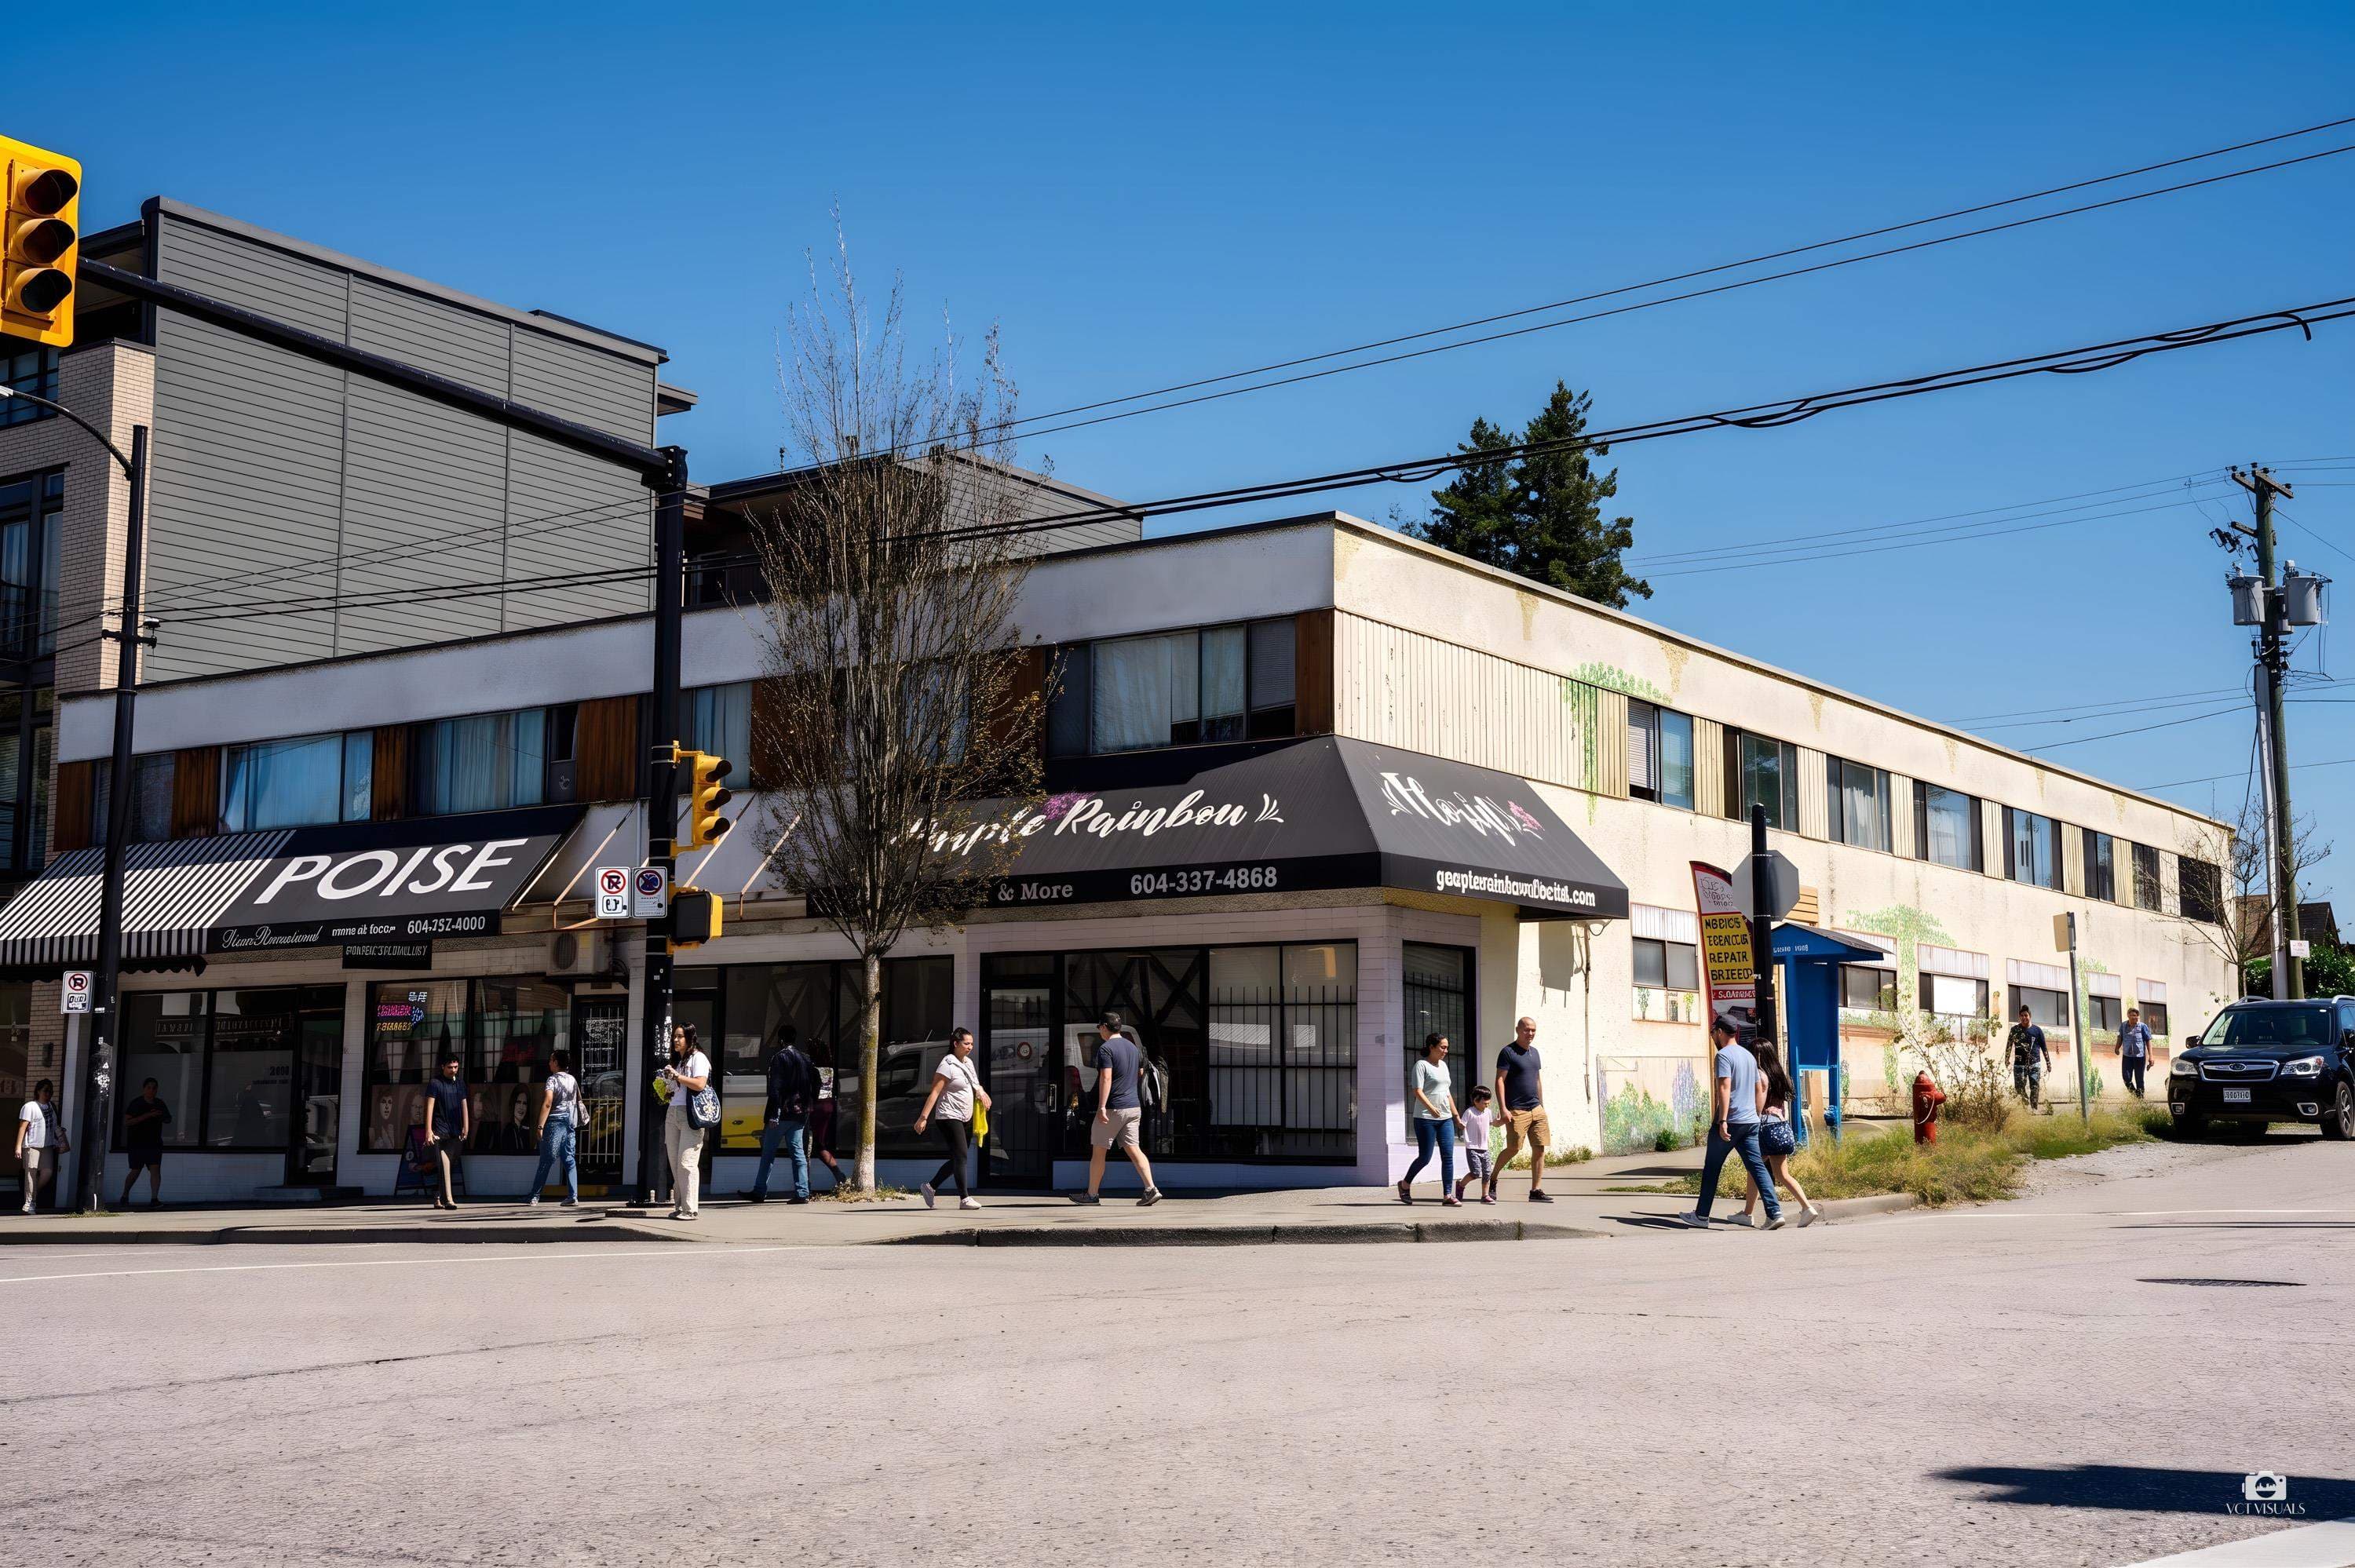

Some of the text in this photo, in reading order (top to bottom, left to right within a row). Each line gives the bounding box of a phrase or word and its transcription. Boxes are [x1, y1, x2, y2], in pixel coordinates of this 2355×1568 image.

[254, 837, 529, 905] POISE
[998, 866, 1277, 901] & More 604-337-4868
